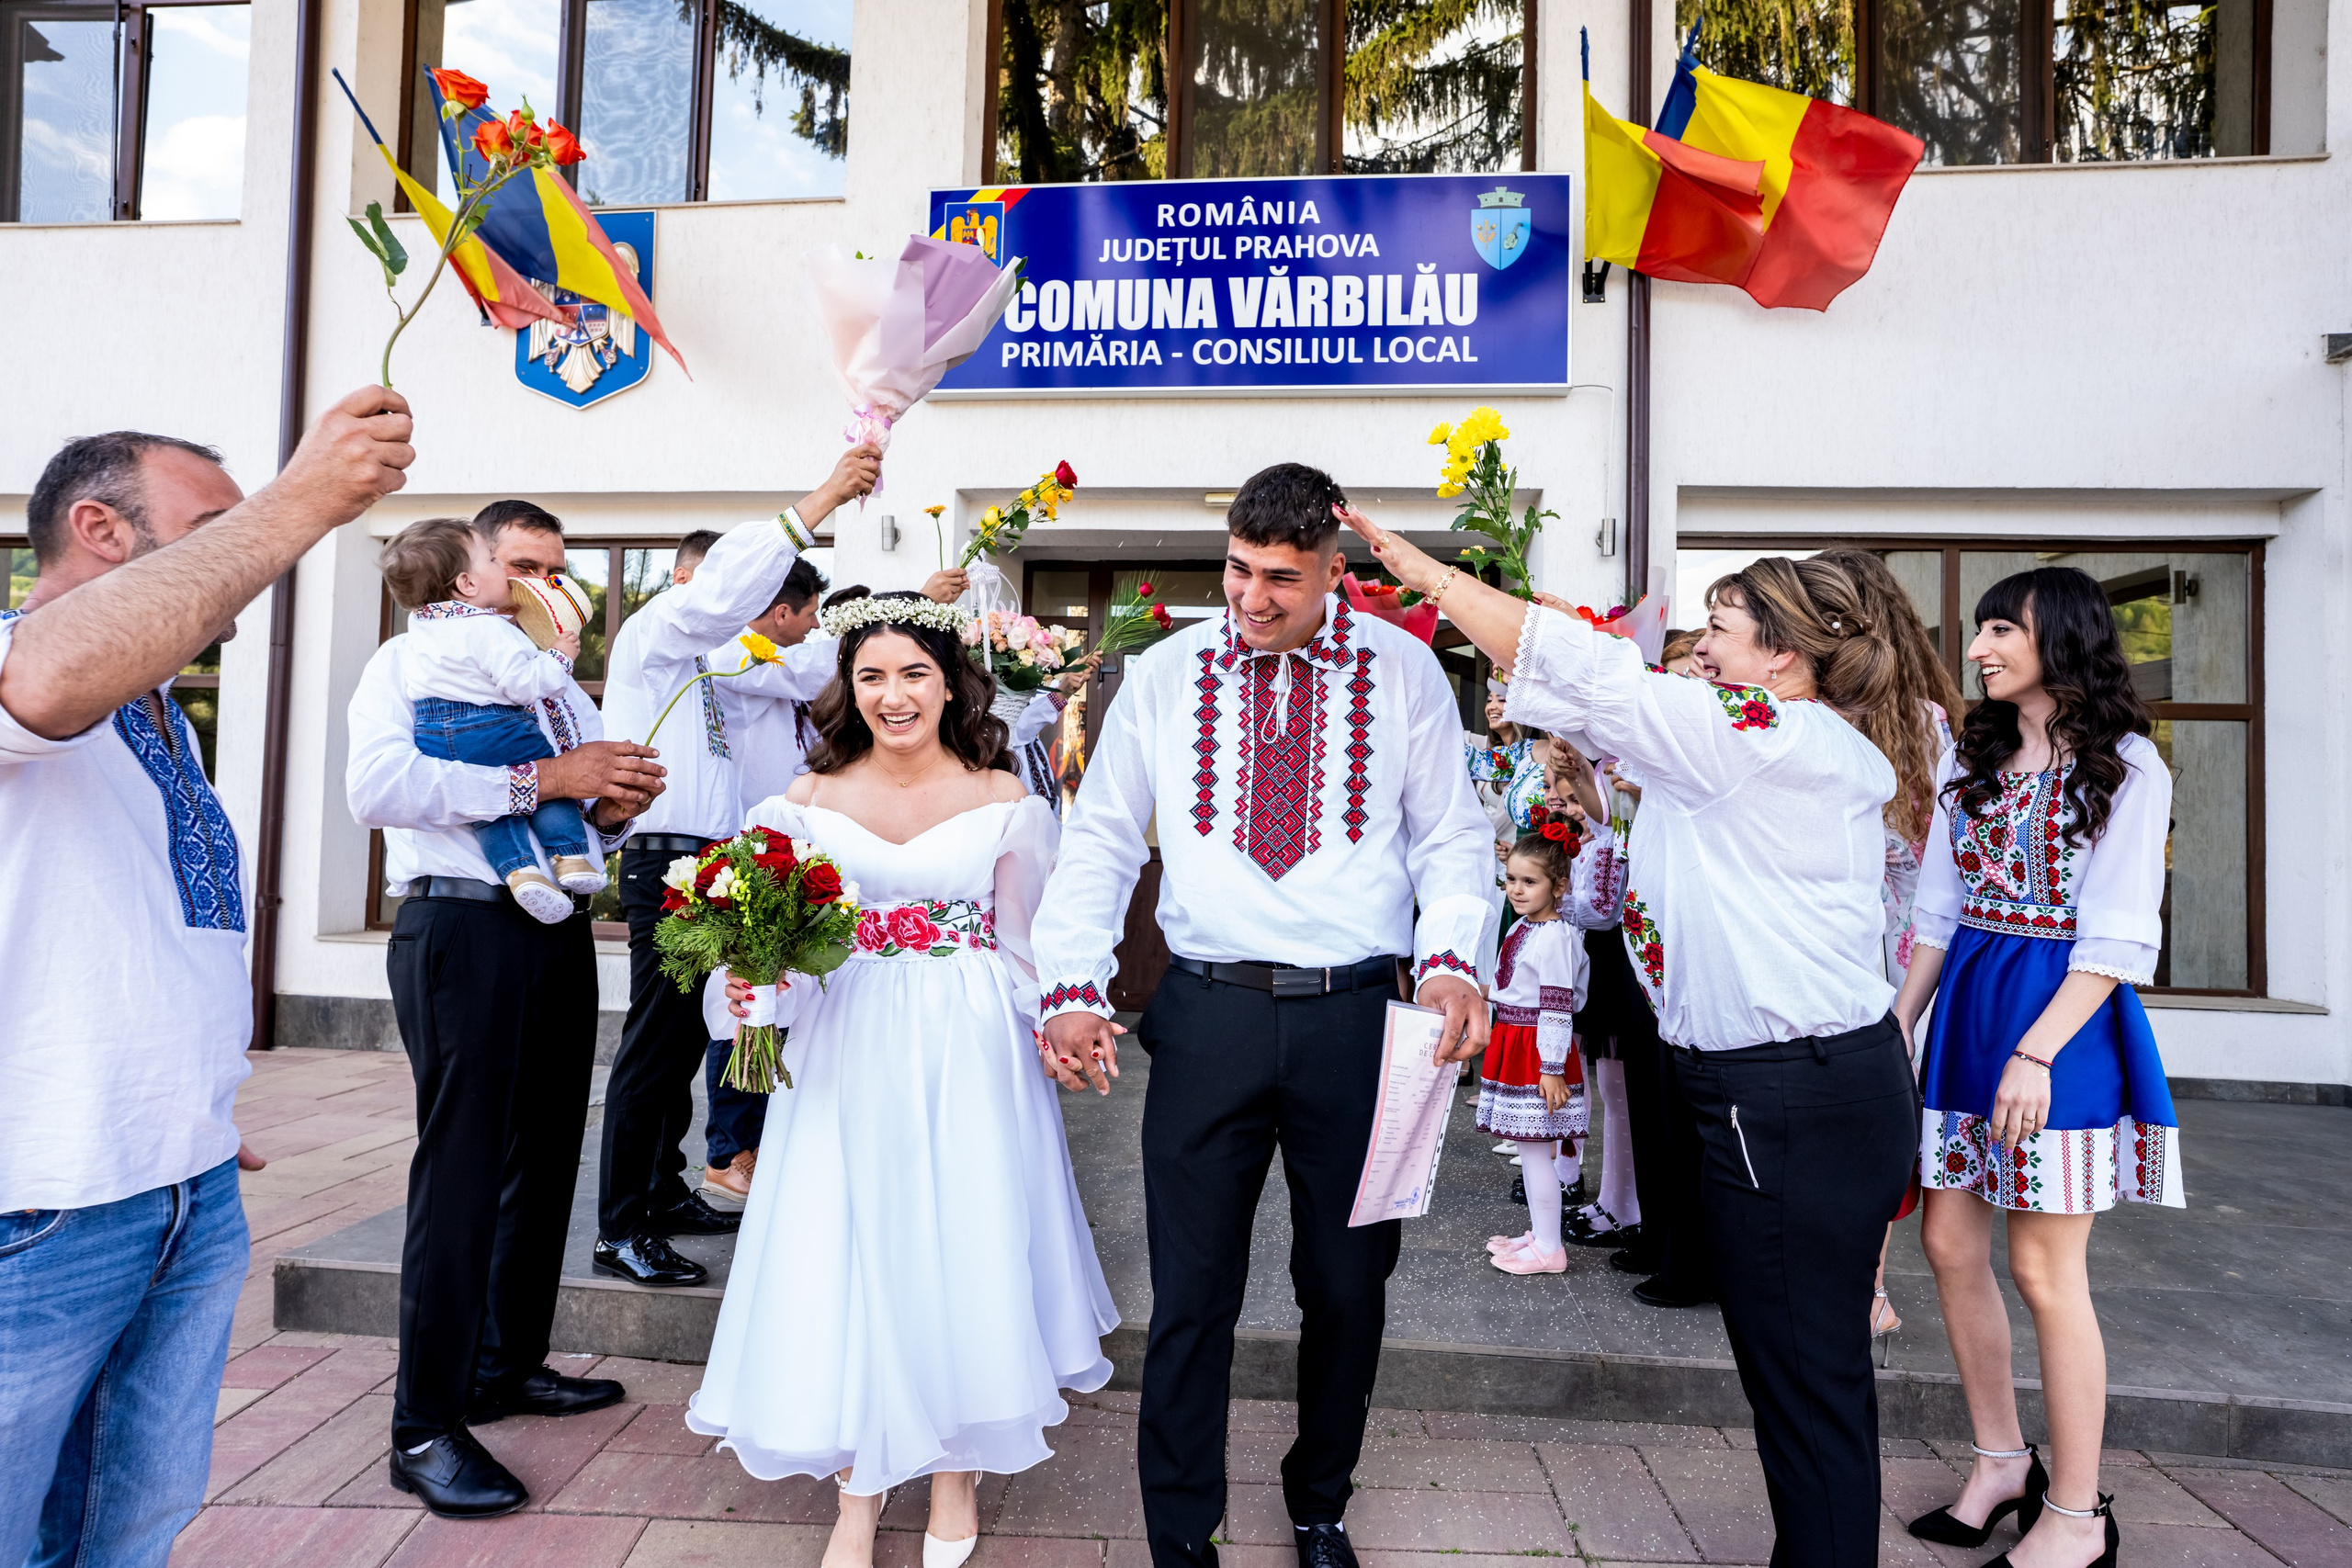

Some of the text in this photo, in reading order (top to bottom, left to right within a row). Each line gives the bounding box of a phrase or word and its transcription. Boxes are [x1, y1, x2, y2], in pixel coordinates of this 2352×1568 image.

[1157, 195, 1321, 228] ROMÂNIA
[1098, 231, 1381, 267] JUDEȚUL PRAHOVA
[1003, 262, 1479, 333] COMUNA VĂRBILĂU
[1001, 333, 1164, 368] PRIMĂRIA
[1192, 336, 1364, 366] CONSILIUL
[1373, 335, 1478, 364] LOCAL
